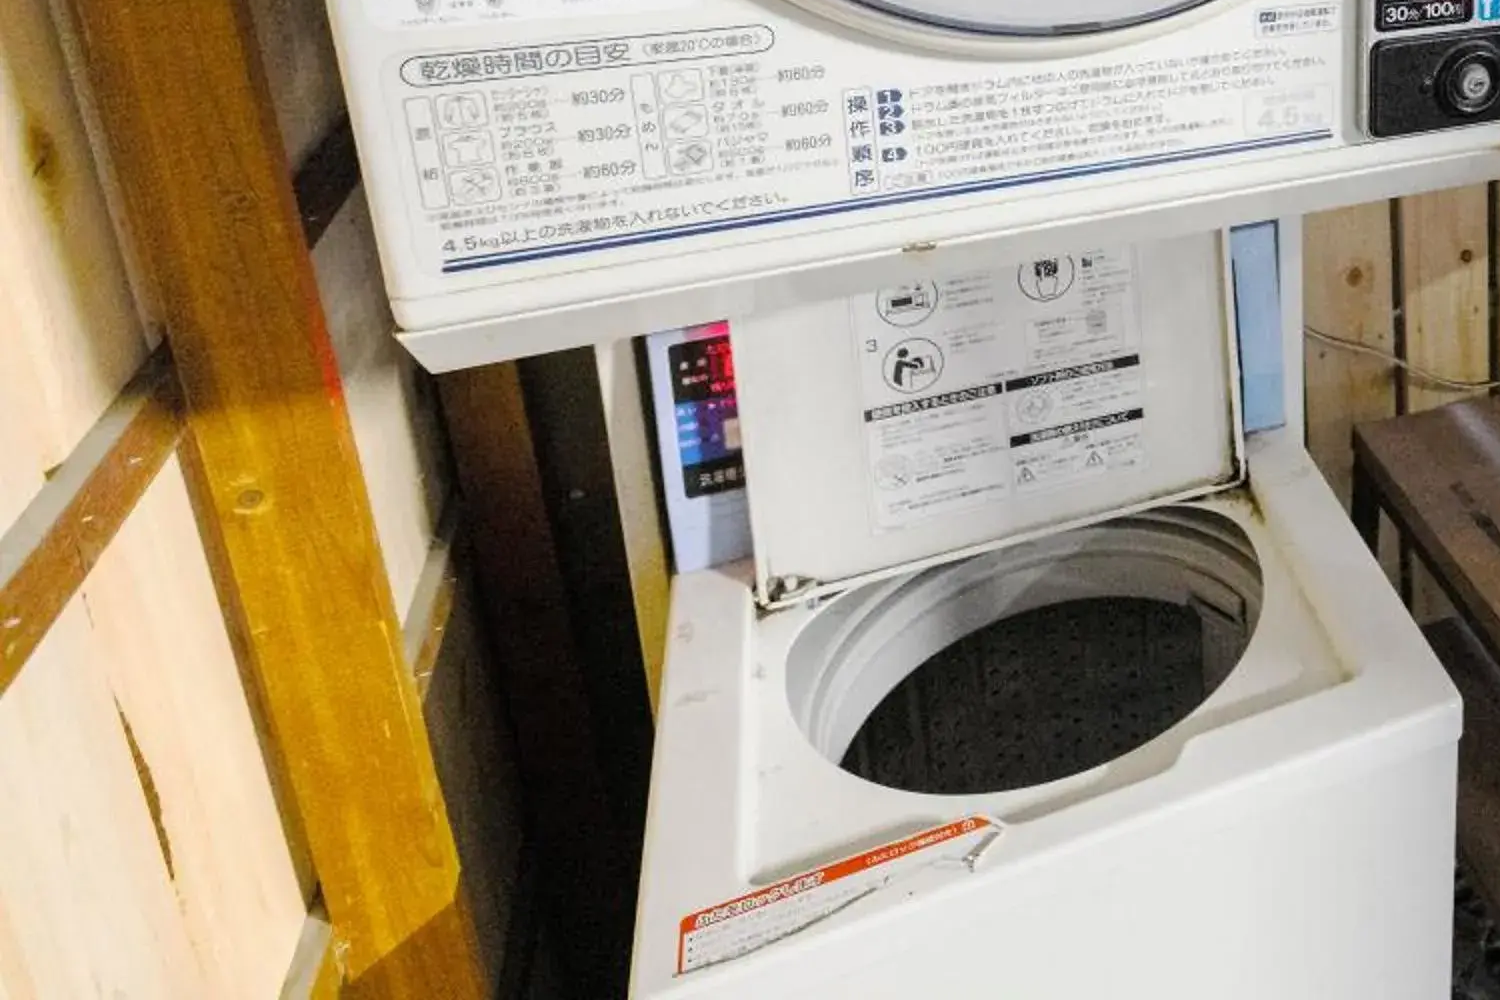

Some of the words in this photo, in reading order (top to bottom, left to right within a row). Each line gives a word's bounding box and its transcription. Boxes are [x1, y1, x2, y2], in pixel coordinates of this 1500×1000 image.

[420, 42, 631, 81] 乾燥時間の目安
